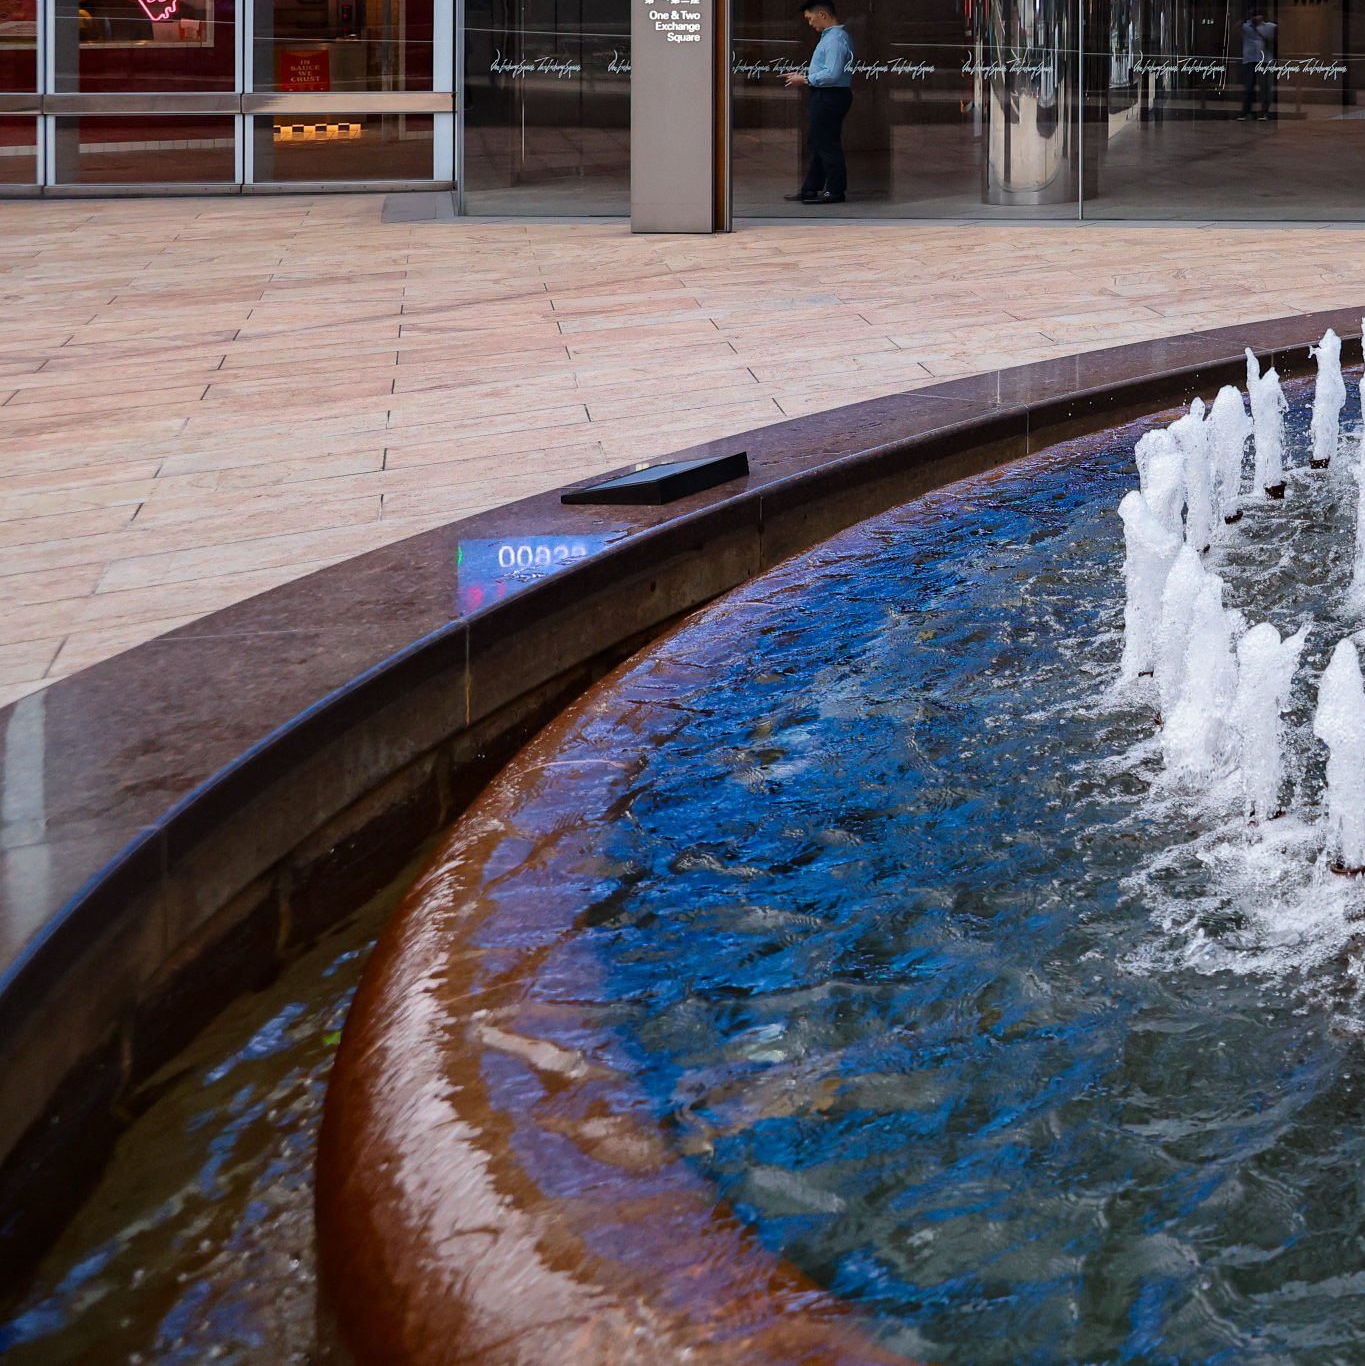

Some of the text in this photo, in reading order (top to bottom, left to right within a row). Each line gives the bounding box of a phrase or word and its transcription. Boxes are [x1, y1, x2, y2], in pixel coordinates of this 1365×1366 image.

[650, 11, 700, 19] One & Two
[656, 22, 700, 32] Exchange
[668, 32, 700, 43] Square
